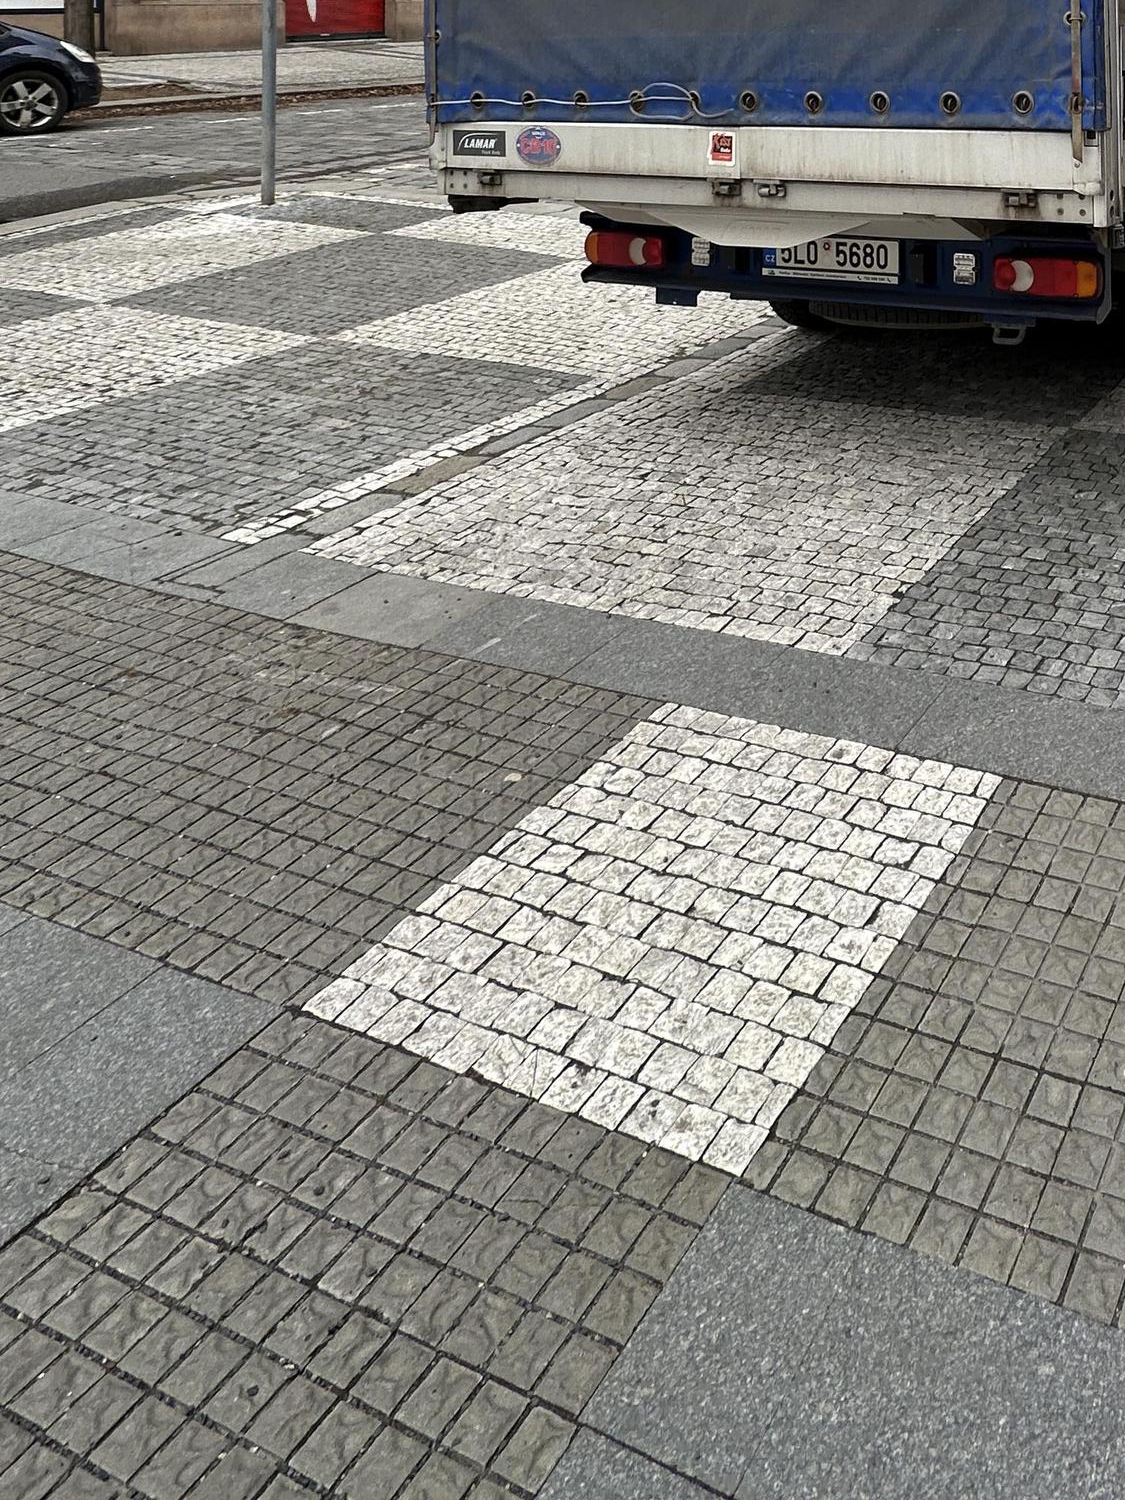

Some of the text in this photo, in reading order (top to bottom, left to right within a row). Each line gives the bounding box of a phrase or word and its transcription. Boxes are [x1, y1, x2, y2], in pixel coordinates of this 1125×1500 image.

[463, 138, 496, 149] LAMAR
[765, 254, 775, 262] CZ
[835, 241, 889, 270] 5680
